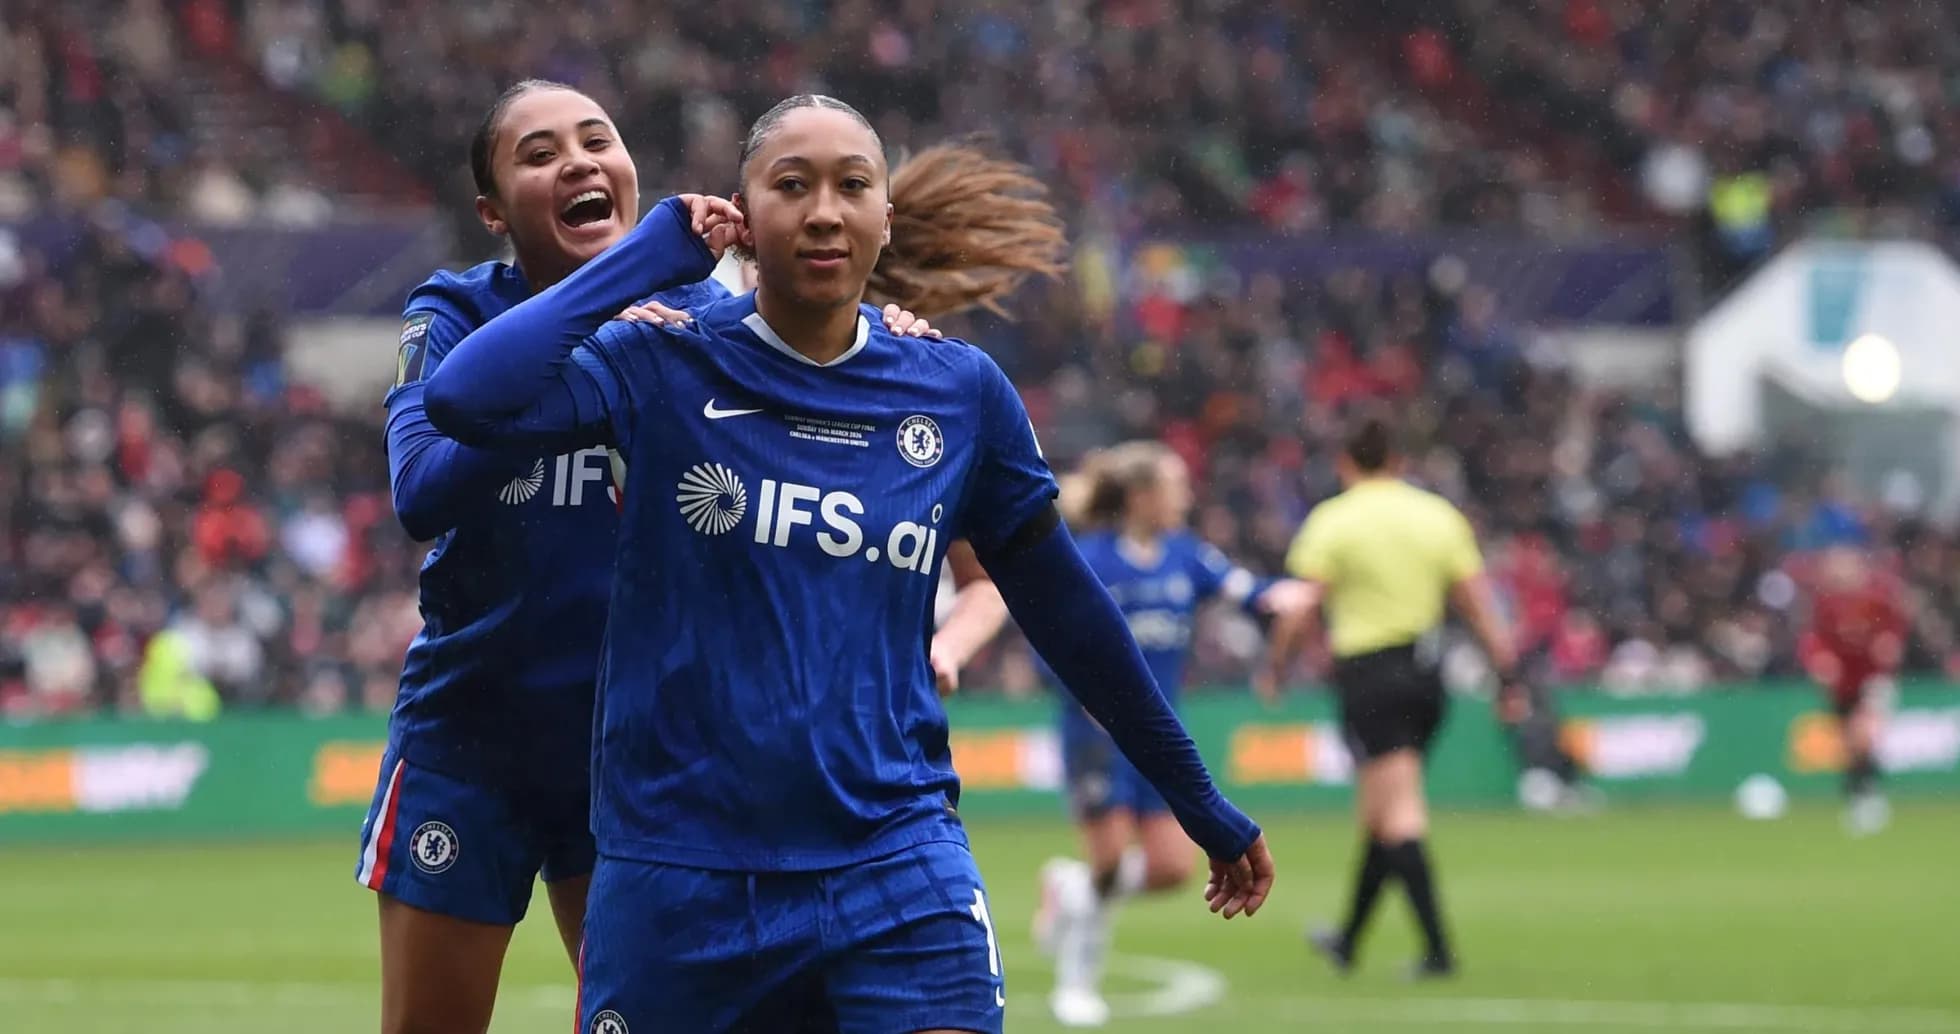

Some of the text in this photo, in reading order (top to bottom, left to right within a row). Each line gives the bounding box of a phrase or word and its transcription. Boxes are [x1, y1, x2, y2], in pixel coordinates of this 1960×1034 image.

[850, 423, 861, 431] CUP
[861, 424, 876, 432] FINAL
[906, 417, 936, 431] CHELSEA
[789, 430, 812, 440] CHELSEA
[815, 435, 850, 445] MANCHESTER
[849, 439, 869, 448] UNITED
[830, 428, 849, 437] MARCH
[552, 445, 617, 506] IF
[754, 479, 943, 576] IFS.ai
[422, 823, 452, 838] CHELSEA
[969, 888, 1004, 976] 1
